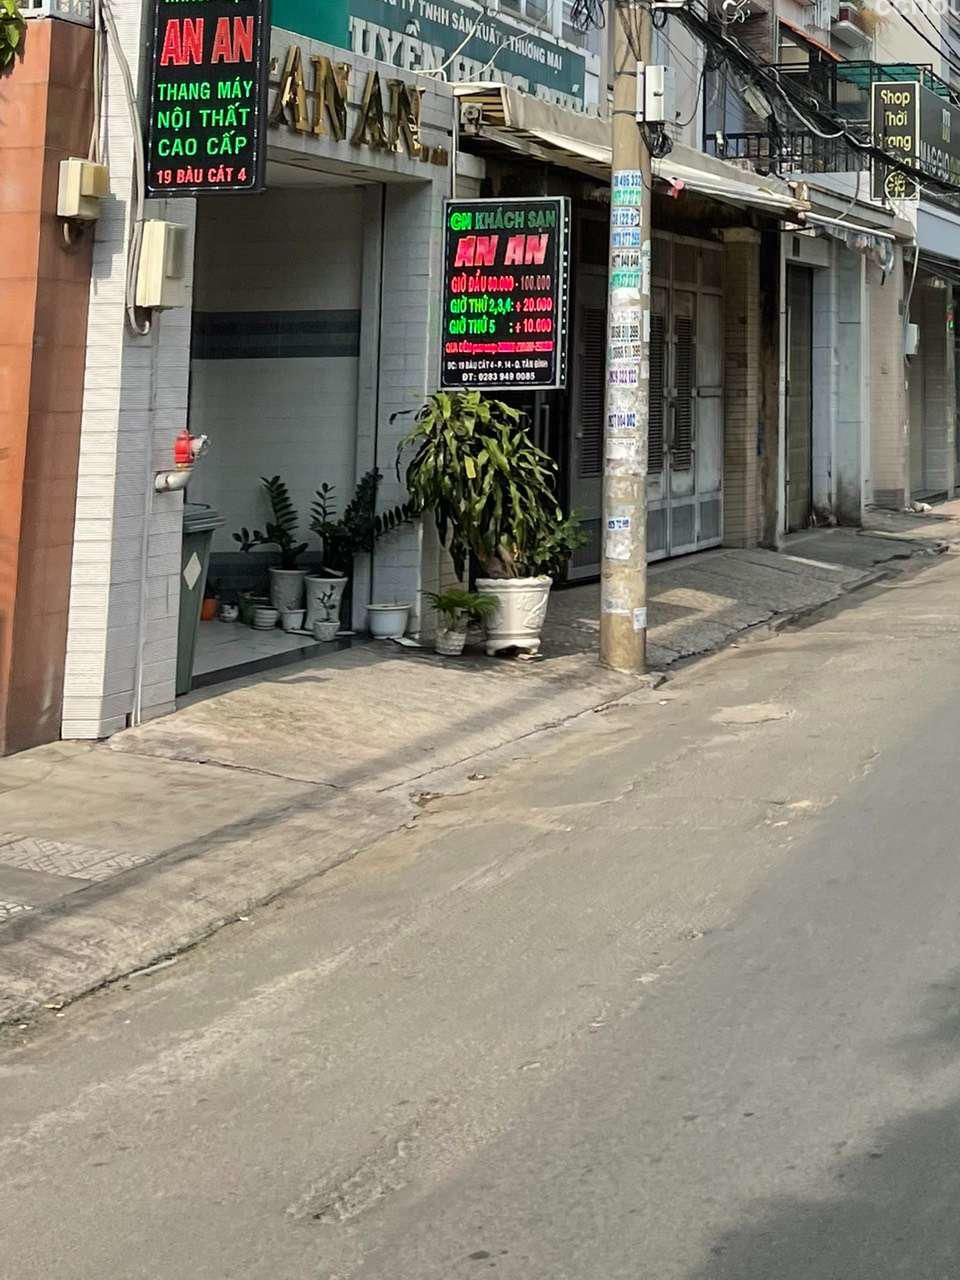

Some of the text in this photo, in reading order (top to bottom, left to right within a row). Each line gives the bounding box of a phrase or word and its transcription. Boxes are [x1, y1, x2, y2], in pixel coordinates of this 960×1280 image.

[159, 15, 254, 66] AN AN
[418, 0, 450, 28] TNHH
[451, 8, 475, 37] SẢN
[508, 34, 547, 65] THƯƠNG
[546, 53, 563, 75] MẠI
[157, 76, 253, 101] THANG MÁY
[880, 90, 911, 106] Shop
[157, 102, 251, 132] NỘI THẤT
[158, 130, 247, 157] CAO CẤP
[157, 164, 247, 184] 19 BÀU CÁT 4
[451, 207, 556, 233] CN KHÁCH SẠN
[454, 234, 549, 267] AN AN
[450, 295, 467, 313] GIỜ
[449, 315, 467, 334] GIỜ
[499, 372, 515, 381] 949
